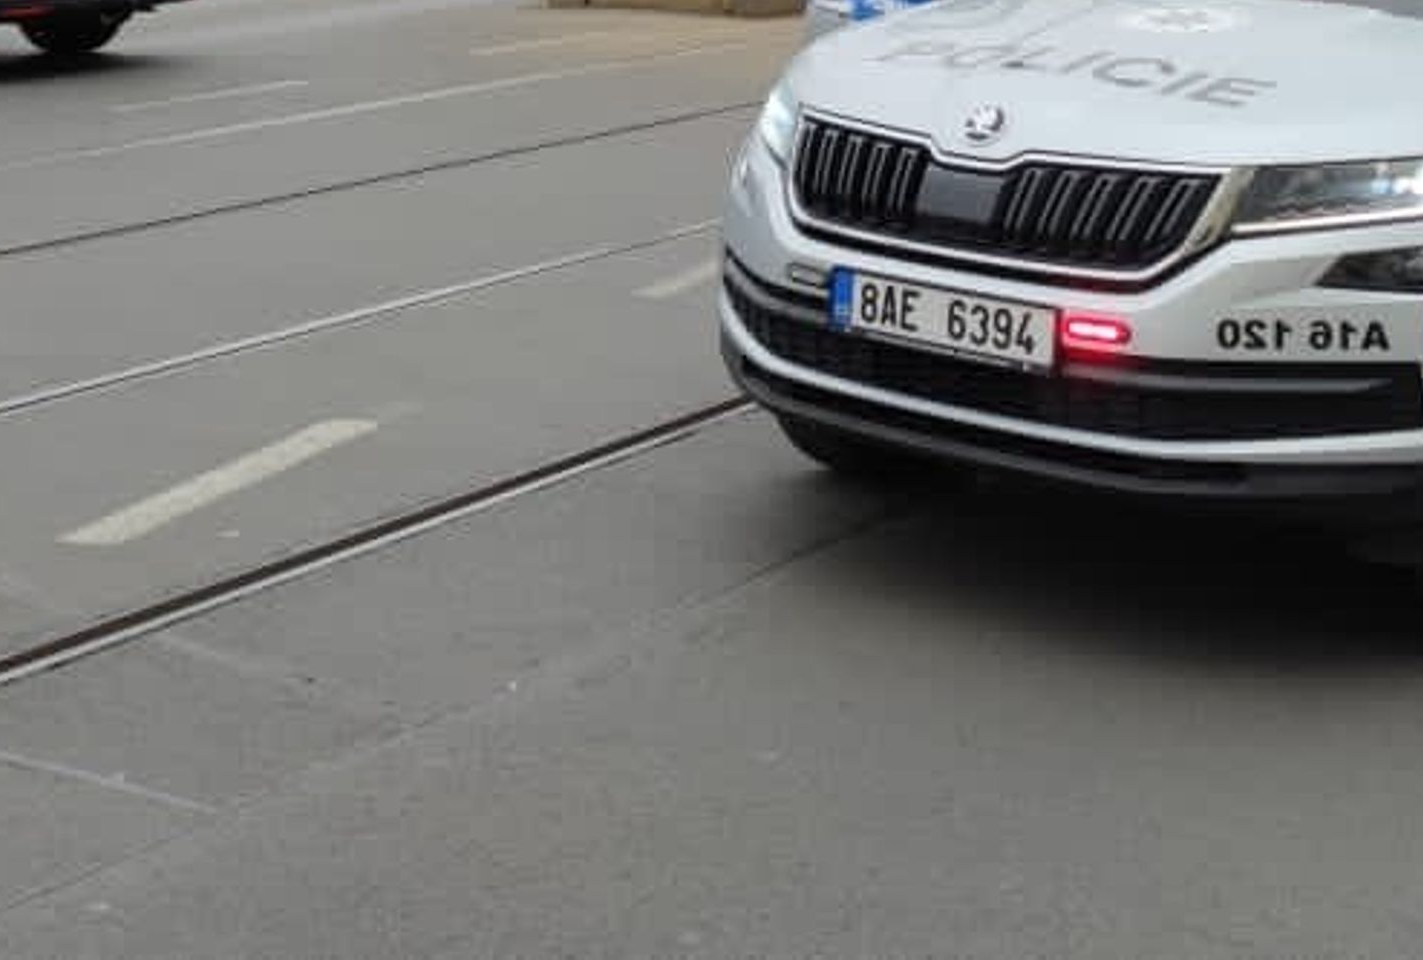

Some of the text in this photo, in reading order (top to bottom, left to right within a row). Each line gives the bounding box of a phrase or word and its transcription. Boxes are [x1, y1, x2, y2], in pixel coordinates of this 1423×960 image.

[866, 41, 1277, 108] POLICIE
[860, 283, 1034, 355] 8AE 6394
